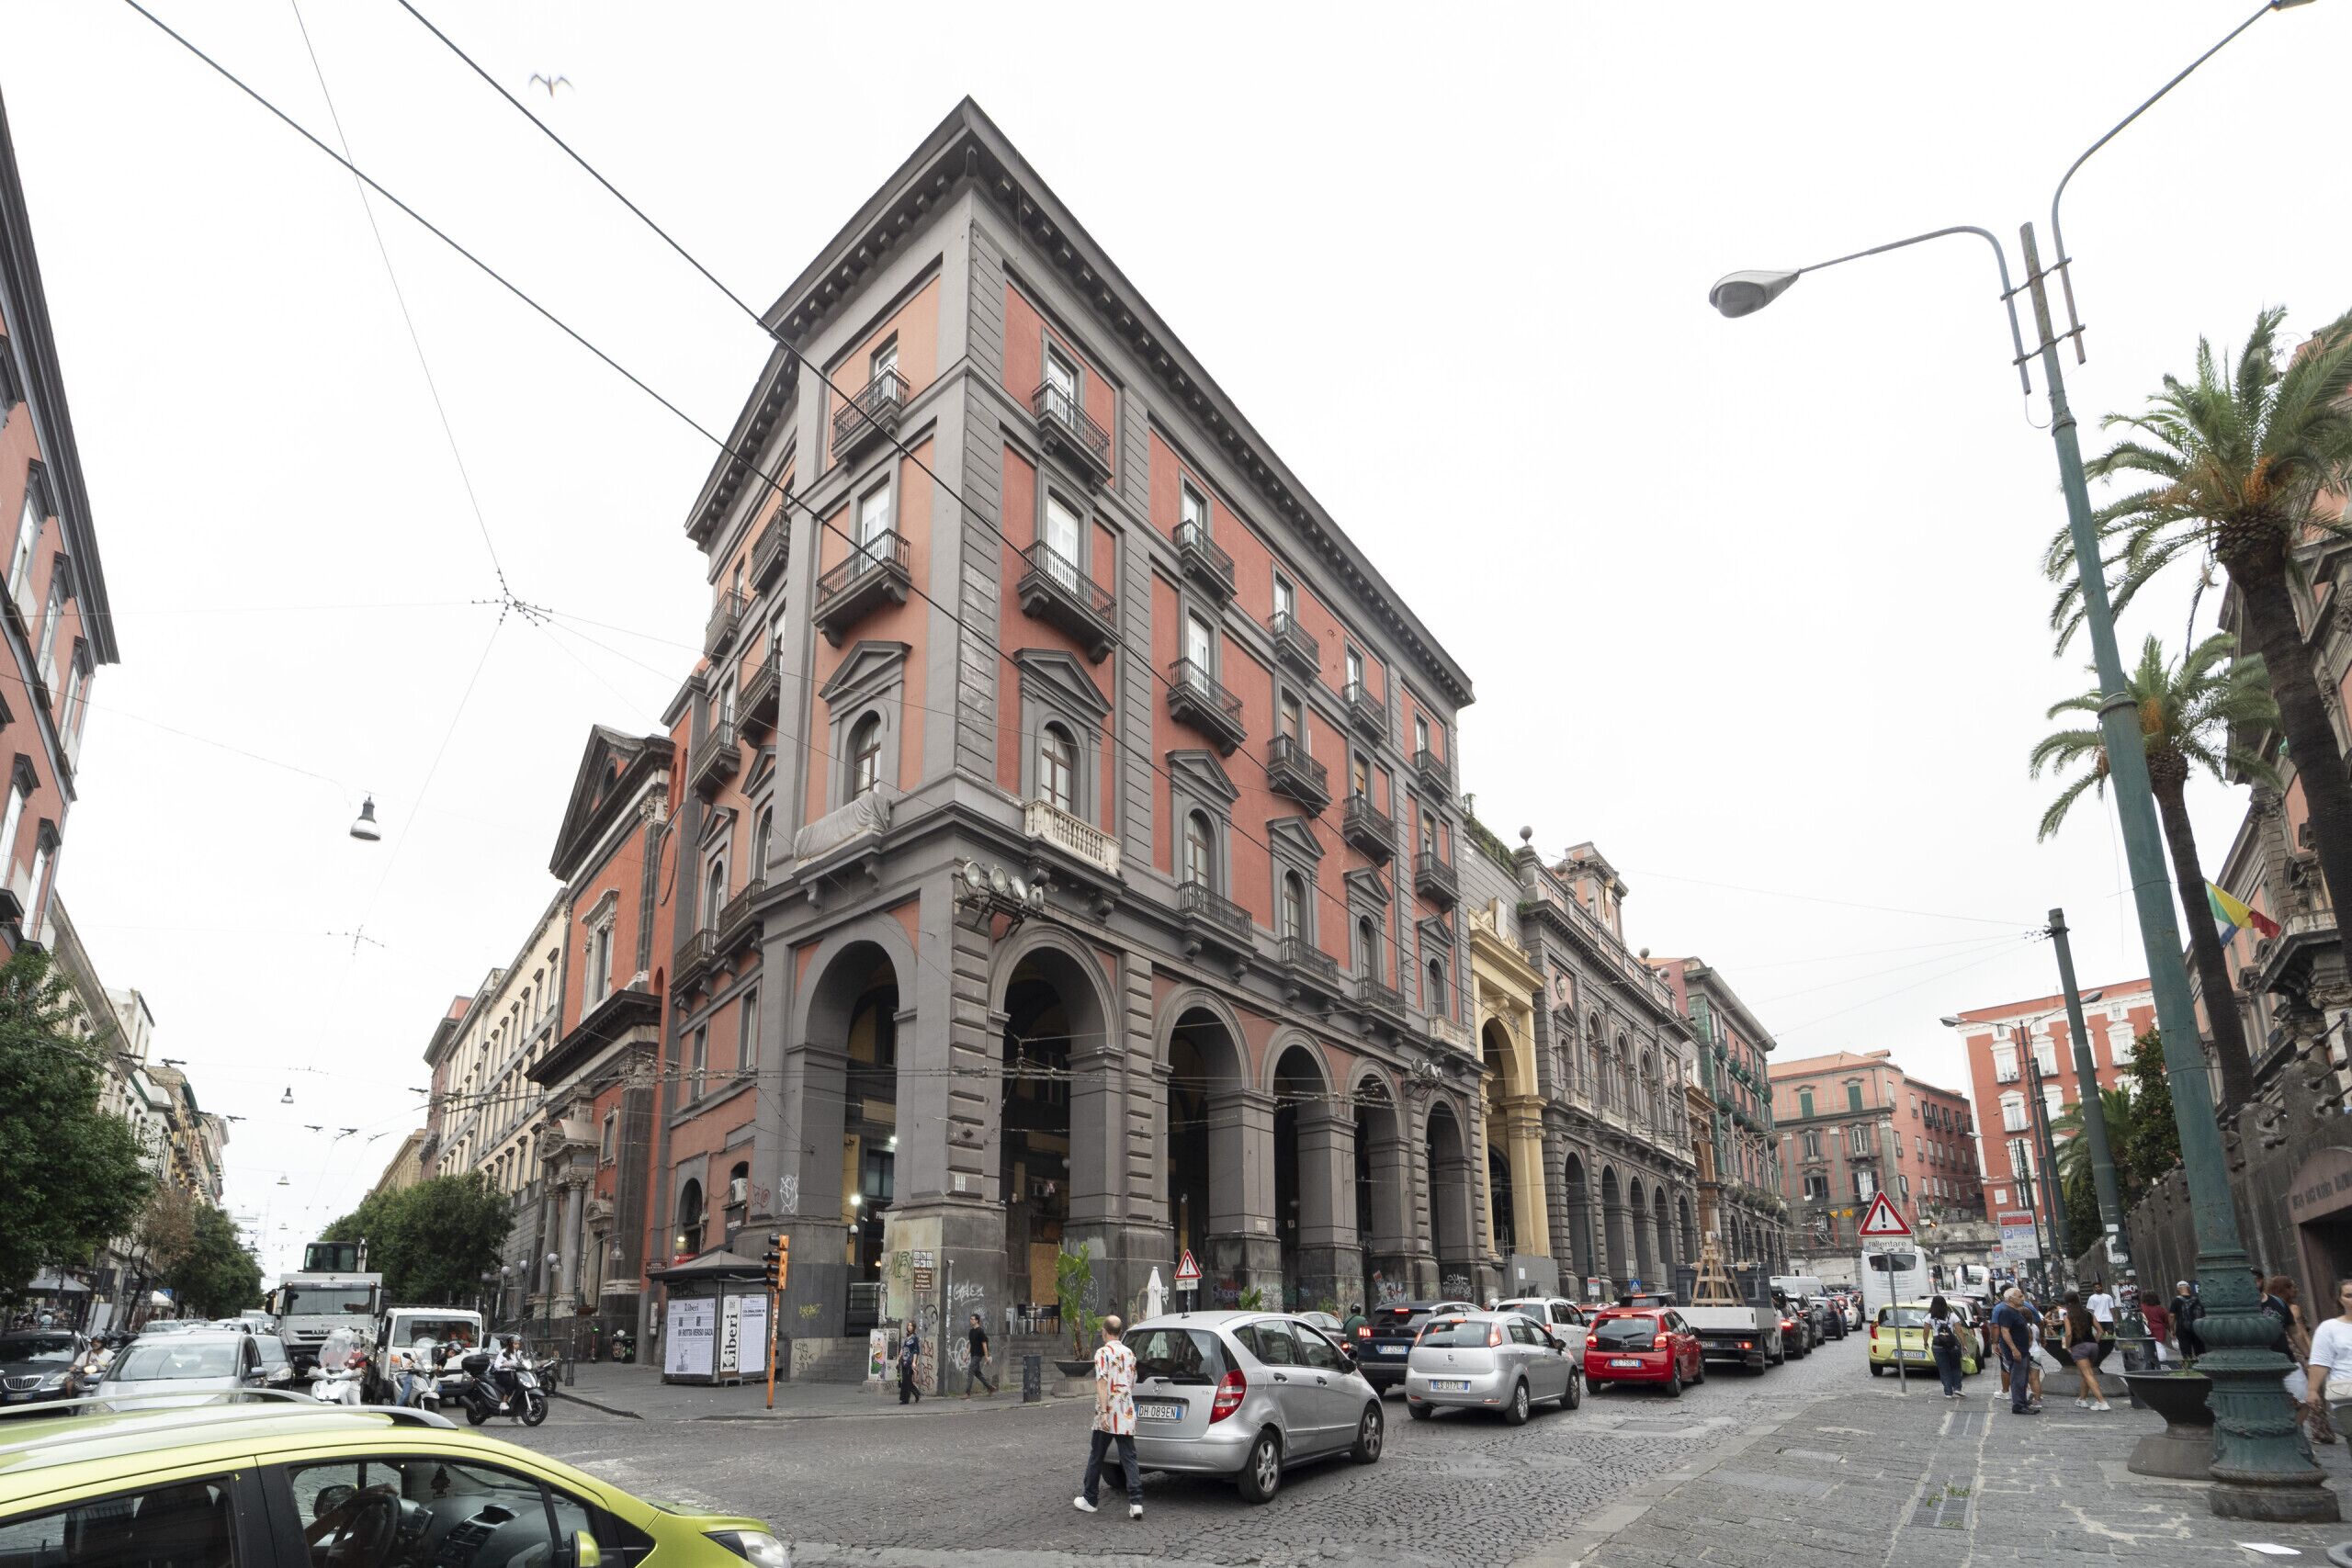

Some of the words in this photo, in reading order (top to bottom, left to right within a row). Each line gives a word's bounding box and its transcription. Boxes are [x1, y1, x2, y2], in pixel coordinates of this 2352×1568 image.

[684, 1303, 699, 1312] Liberi
[704, 1328, 713, 1337] GAZA
[722, 1314, 738, 1370] Liberi
[1138, 1405, 1149, 1416] DH
[1151, 1406, 1176, 1418] 089EN
